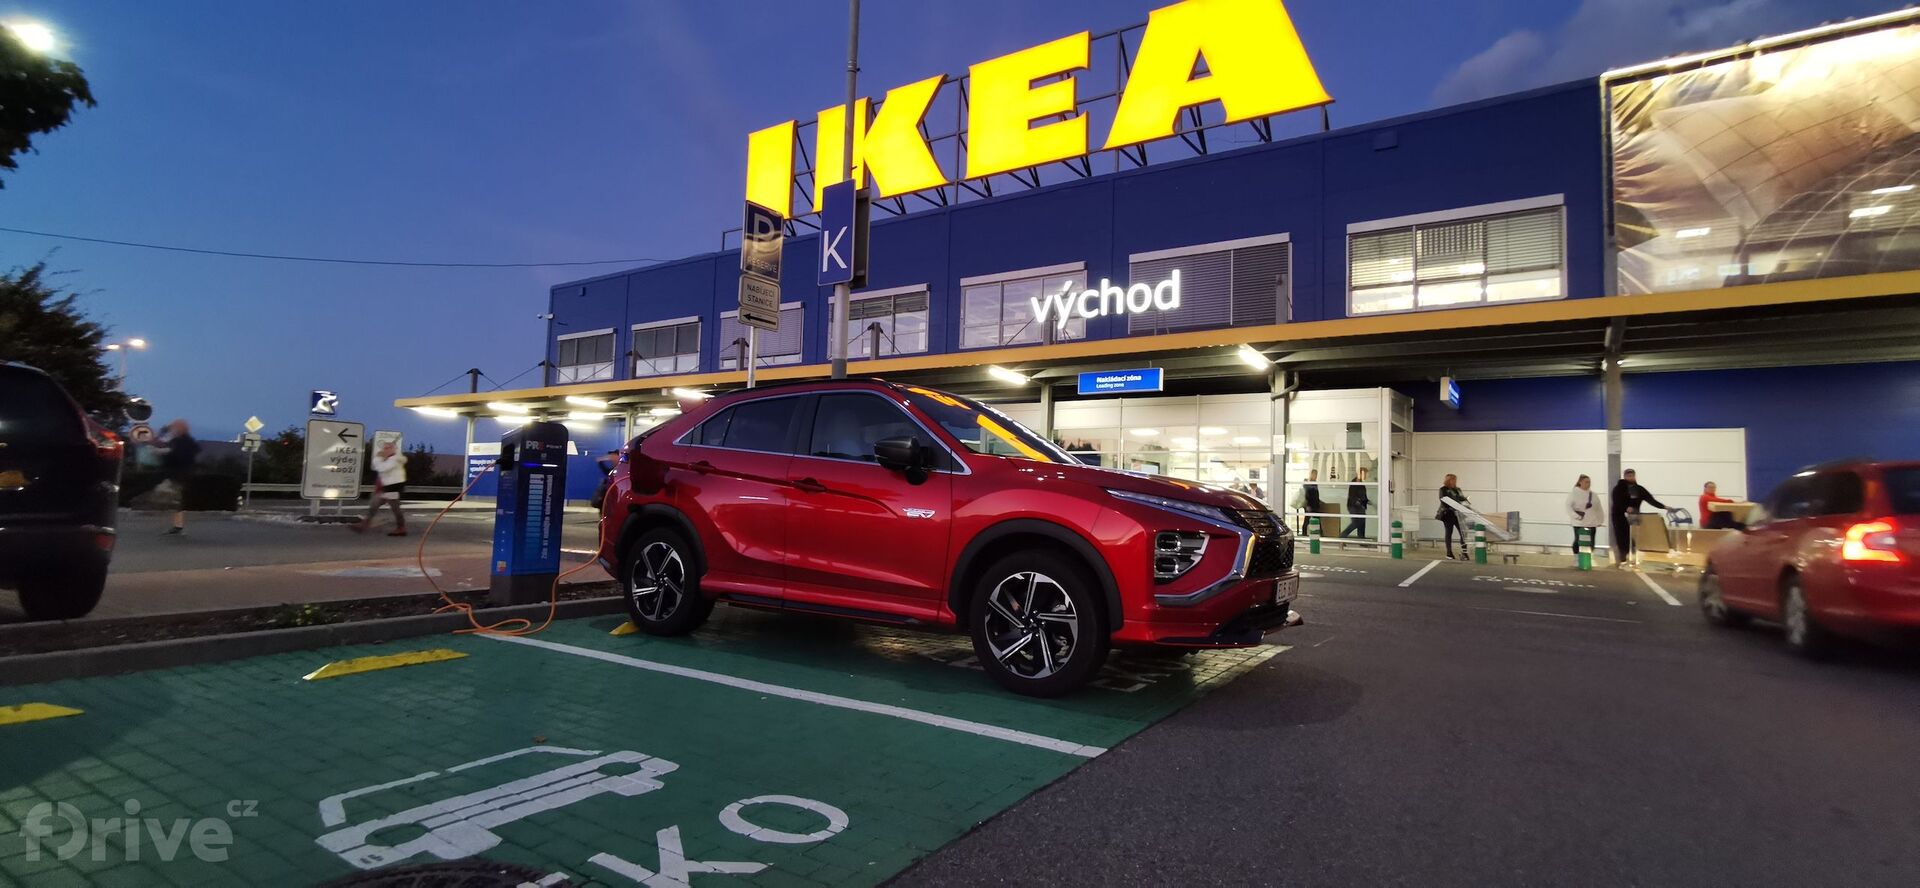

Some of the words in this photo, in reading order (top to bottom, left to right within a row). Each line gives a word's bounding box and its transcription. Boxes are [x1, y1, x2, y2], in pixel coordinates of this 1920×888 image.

[746, 0, 1335, 219] IKEA
[753, 212, 775, 248] P
[822, 225, 848, 272] K
[747, 294, 774, 308] STANICE
[1030, 268, 1181, 330] východ
[330, 456, 357, 465] výdej
[335, 446, 358, 455] IKEA
